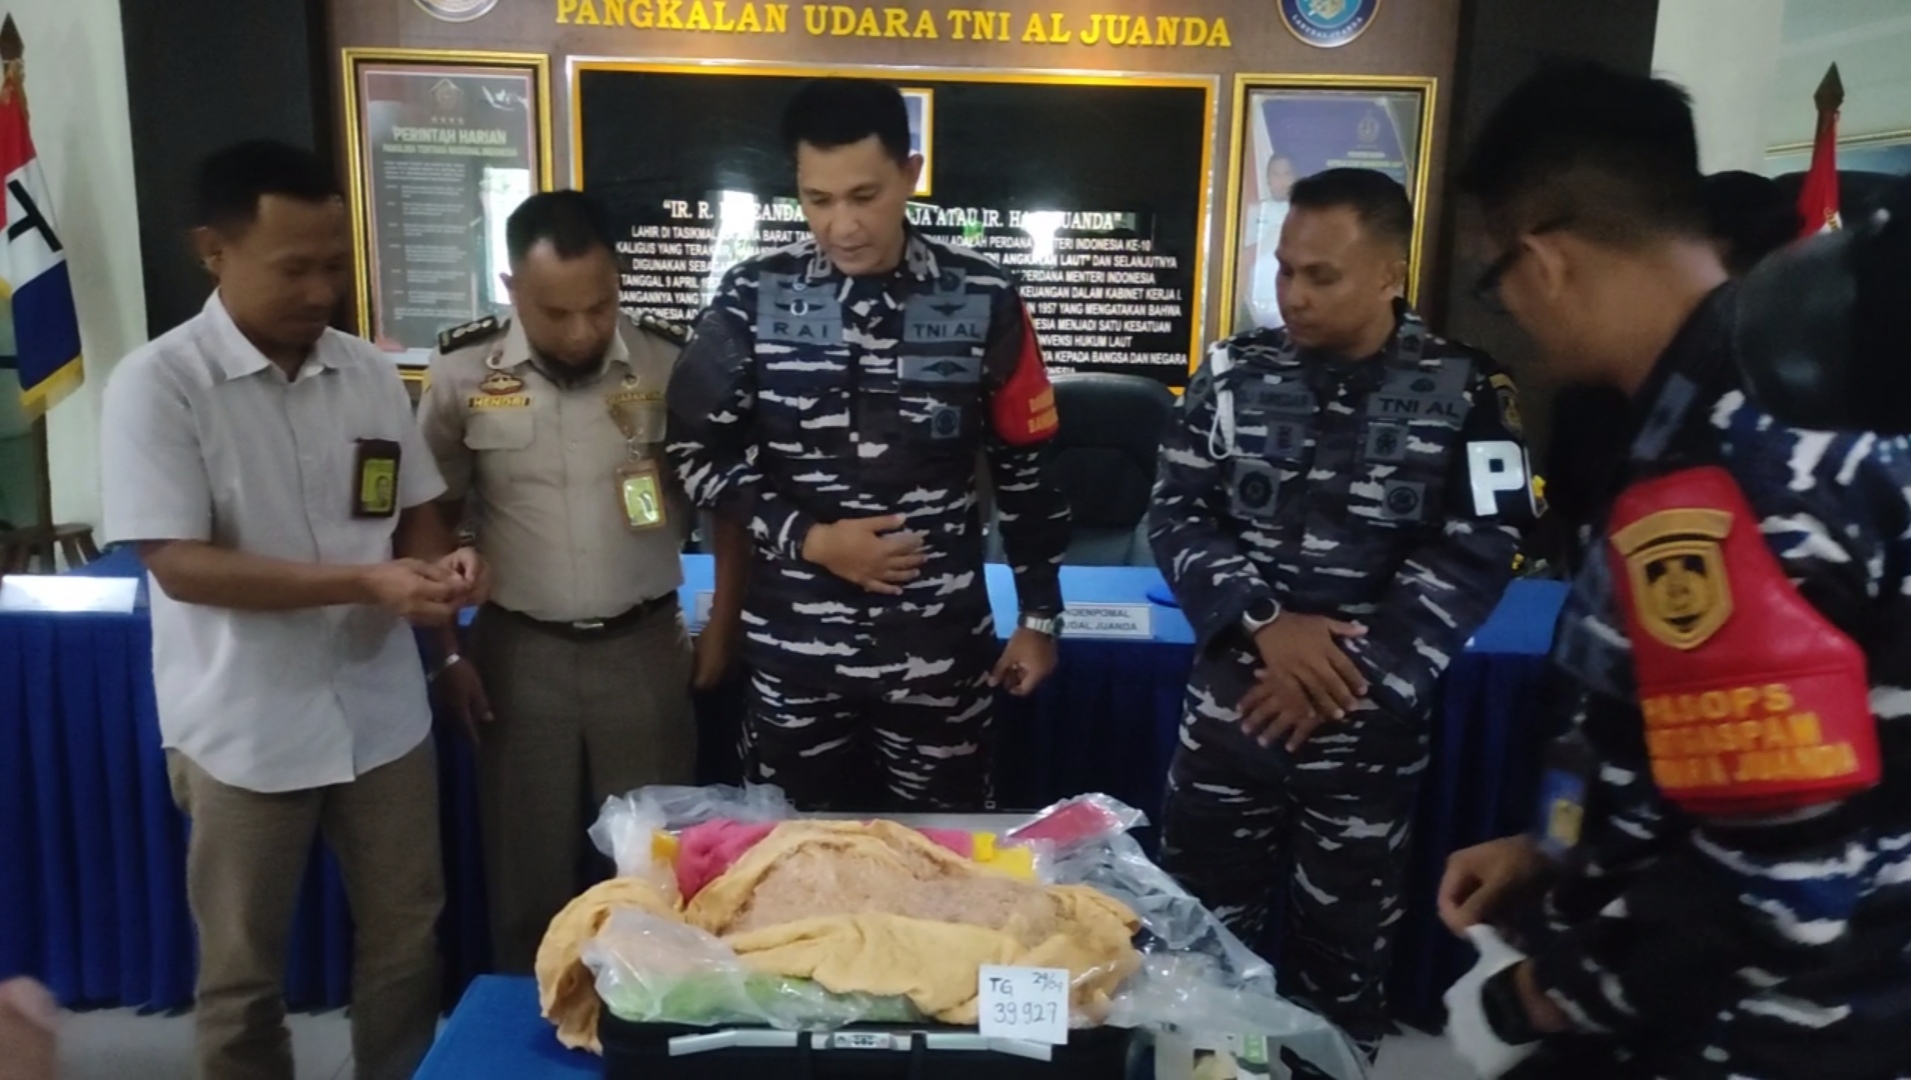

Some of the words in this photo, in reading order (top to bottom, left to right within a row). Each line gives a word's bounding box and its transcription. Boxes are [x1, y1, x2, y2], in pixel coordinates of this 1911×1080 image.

[555, 0, 788, 32] PANGKALAN
[803, 5, 938, 38] UDARA
[947, 10, 1011, 41] TNI
[1021, 13, 1071, 43] AL
[1080, 14, 1231, 47] JUANDA
[392, 126, 456, 144] PERINTAH
[458, 128, 507, 145] HARIAN
[698, 201, 714, 219] R.
[982, 209, 1003, 227] IR.
[632, 226, 658, 237] LAHIR
[662, 226, 671, 238] DI
[1075, 239, 1123, 251] INDONESIA
[1125, 239, 1151, 252] KE-10
[658, 242, 682, 254] YANG
[1092, 255, 1111, 267] DAN
[1113, 256, 1177, 268] SELANJUTNYA
[632, 258, 687, 271] DIGUNAKAN
[1065, 271, 1105, 283] MENTERI
[1107, 271, 1155, 284] INDONESIA
[621, 274, 664, 287] TANGGAL
[673, 275, 699, 288] APRIL
[1020, 286, 1069, 298] KEUANGAN
[1071, 287, 1103, 299] DALAM
[1105, 288, 1144, 300] KABINET
[1146, 289, 1175, 301] KERJA
[674, 292, 699, 304] YANG
[1059, 303, 1083, 315] YANG
[1085, 303, 1146, 316] MENGATAKAN
[1148, 304, 1181, 317] BAHWA
[913, 322, 946, 337] TNI
[953, 323, 981, 339] AL
[1058, 319, 1097, 331] MENJADI
[1099, 320, 1121, 332] SATU
[1124, 321, 1171, 333] KESATUAN
[1074, 335, 1107, 347] HUKUM
[1109, 336, 1133, 347] LAUT
[1055, 352, 1089, 363] KEPADA
[1092, 353, 1128, 364] BANGSA
[1130, 353, 1148, 364] DAN
[1150, 353, 1187, 365] NEGARA
[1379, 398, 1419, 413] TNI
[1425, 401, 1460, 419] AL
[1466, 440, 1525, 516] P
